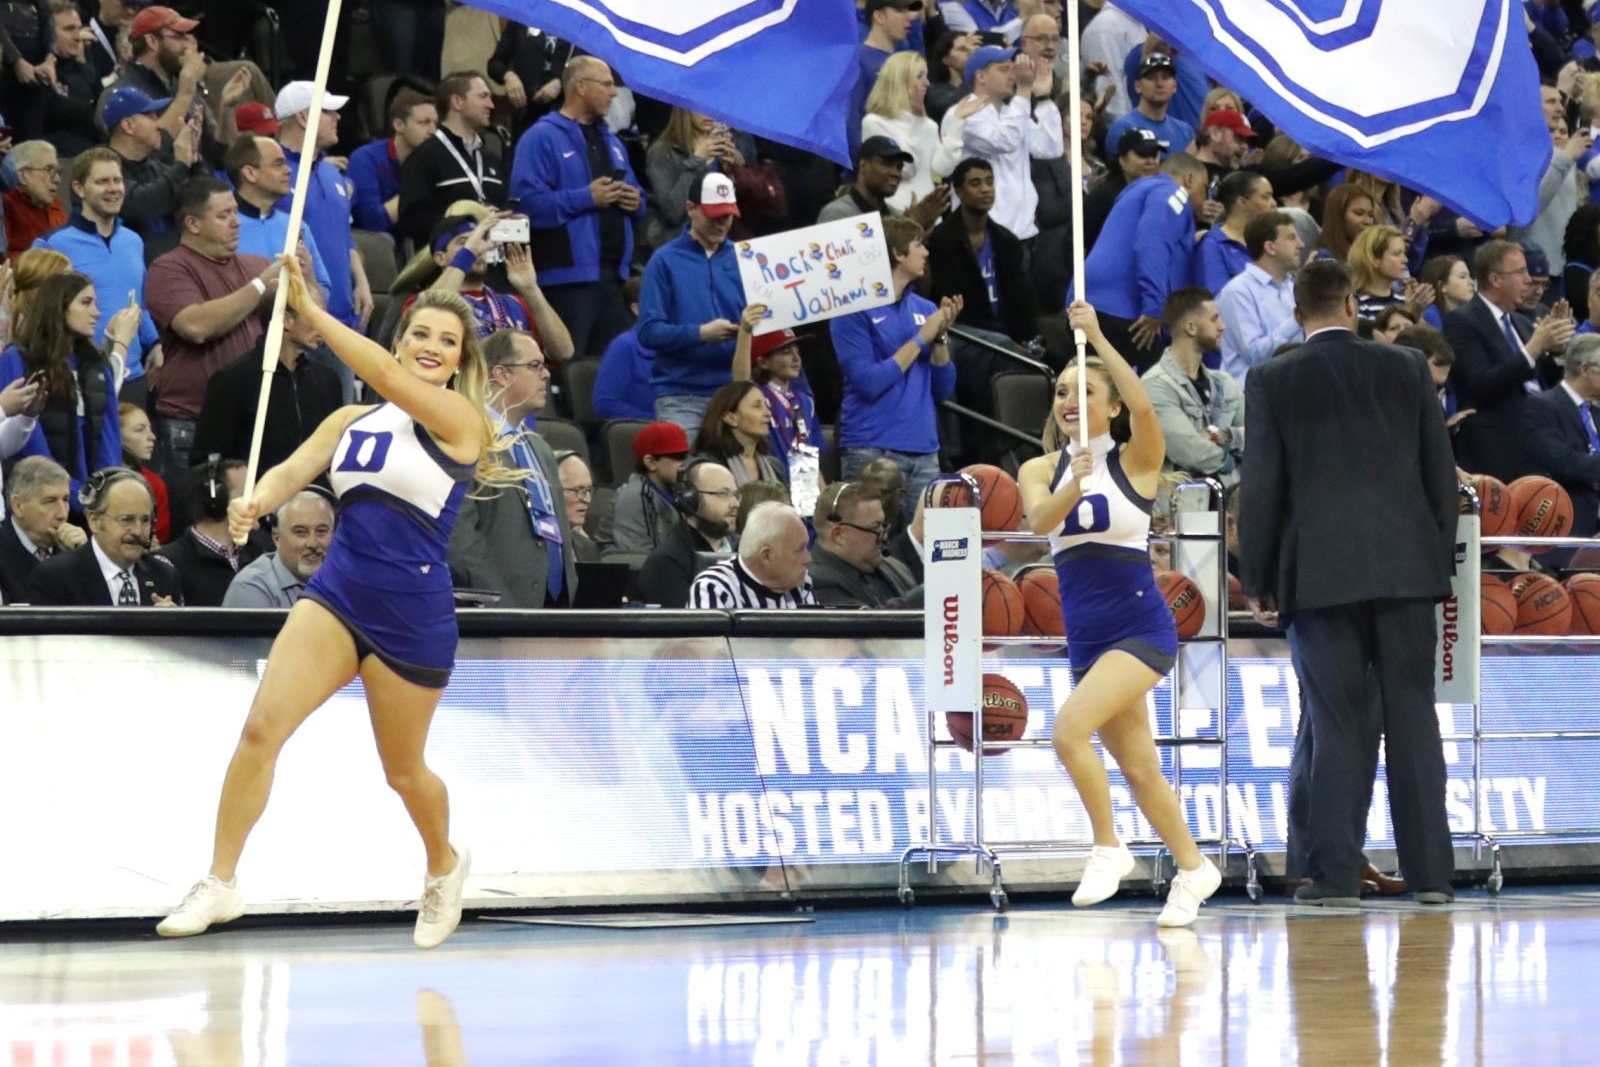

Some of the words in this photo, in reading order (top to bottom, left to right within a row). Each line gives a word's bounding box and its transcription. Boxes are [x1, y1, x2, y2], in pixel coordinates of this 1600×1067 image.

[335, 429, 394, 474] D
[943, 595, 959, 686] Wilson
[1442, 596, 1459, 682] Wilson
[982, 692, 1022, 712] ilson
[684, 789, 895, 859] HOSTED
